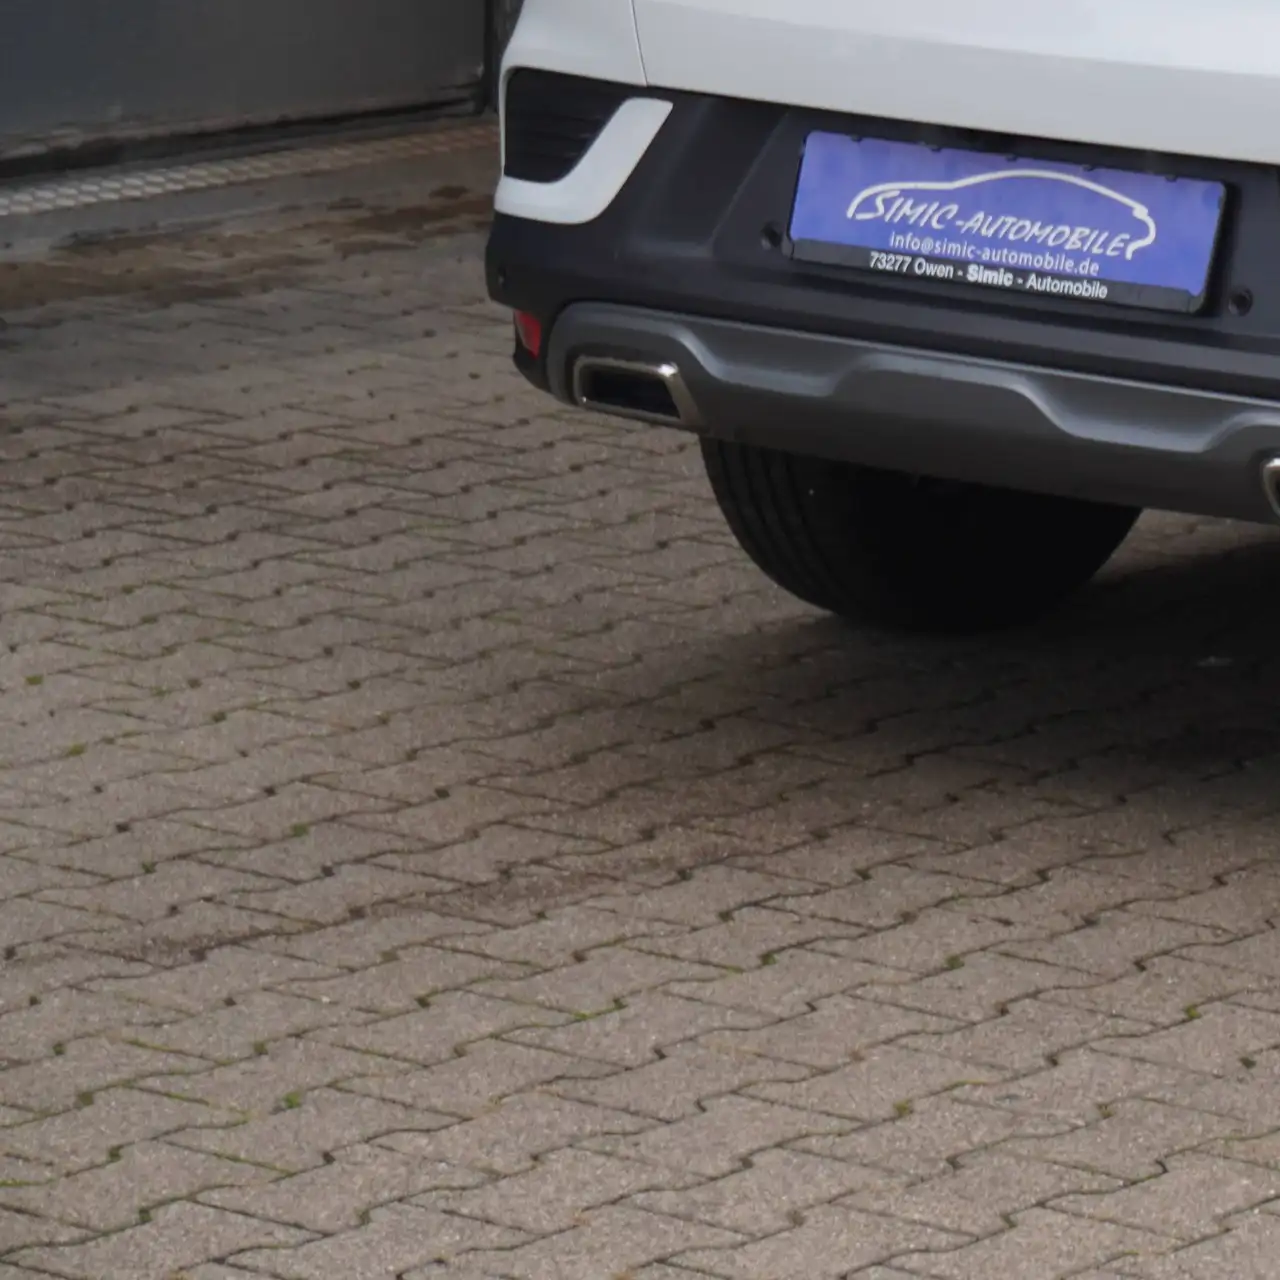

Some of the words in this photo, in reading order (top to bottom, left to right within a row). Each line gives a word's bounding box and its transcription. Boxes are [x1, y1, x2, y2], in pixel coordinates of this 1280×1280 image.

[869, 251, 910, 272] 73277
[914, 256, 954, 279] Owen
[966, 263, 1013, 288] Simic
[1026, 274, 1108, 300] Automobile
[889, 231, 1099, 277] info@simic-automobile.de
